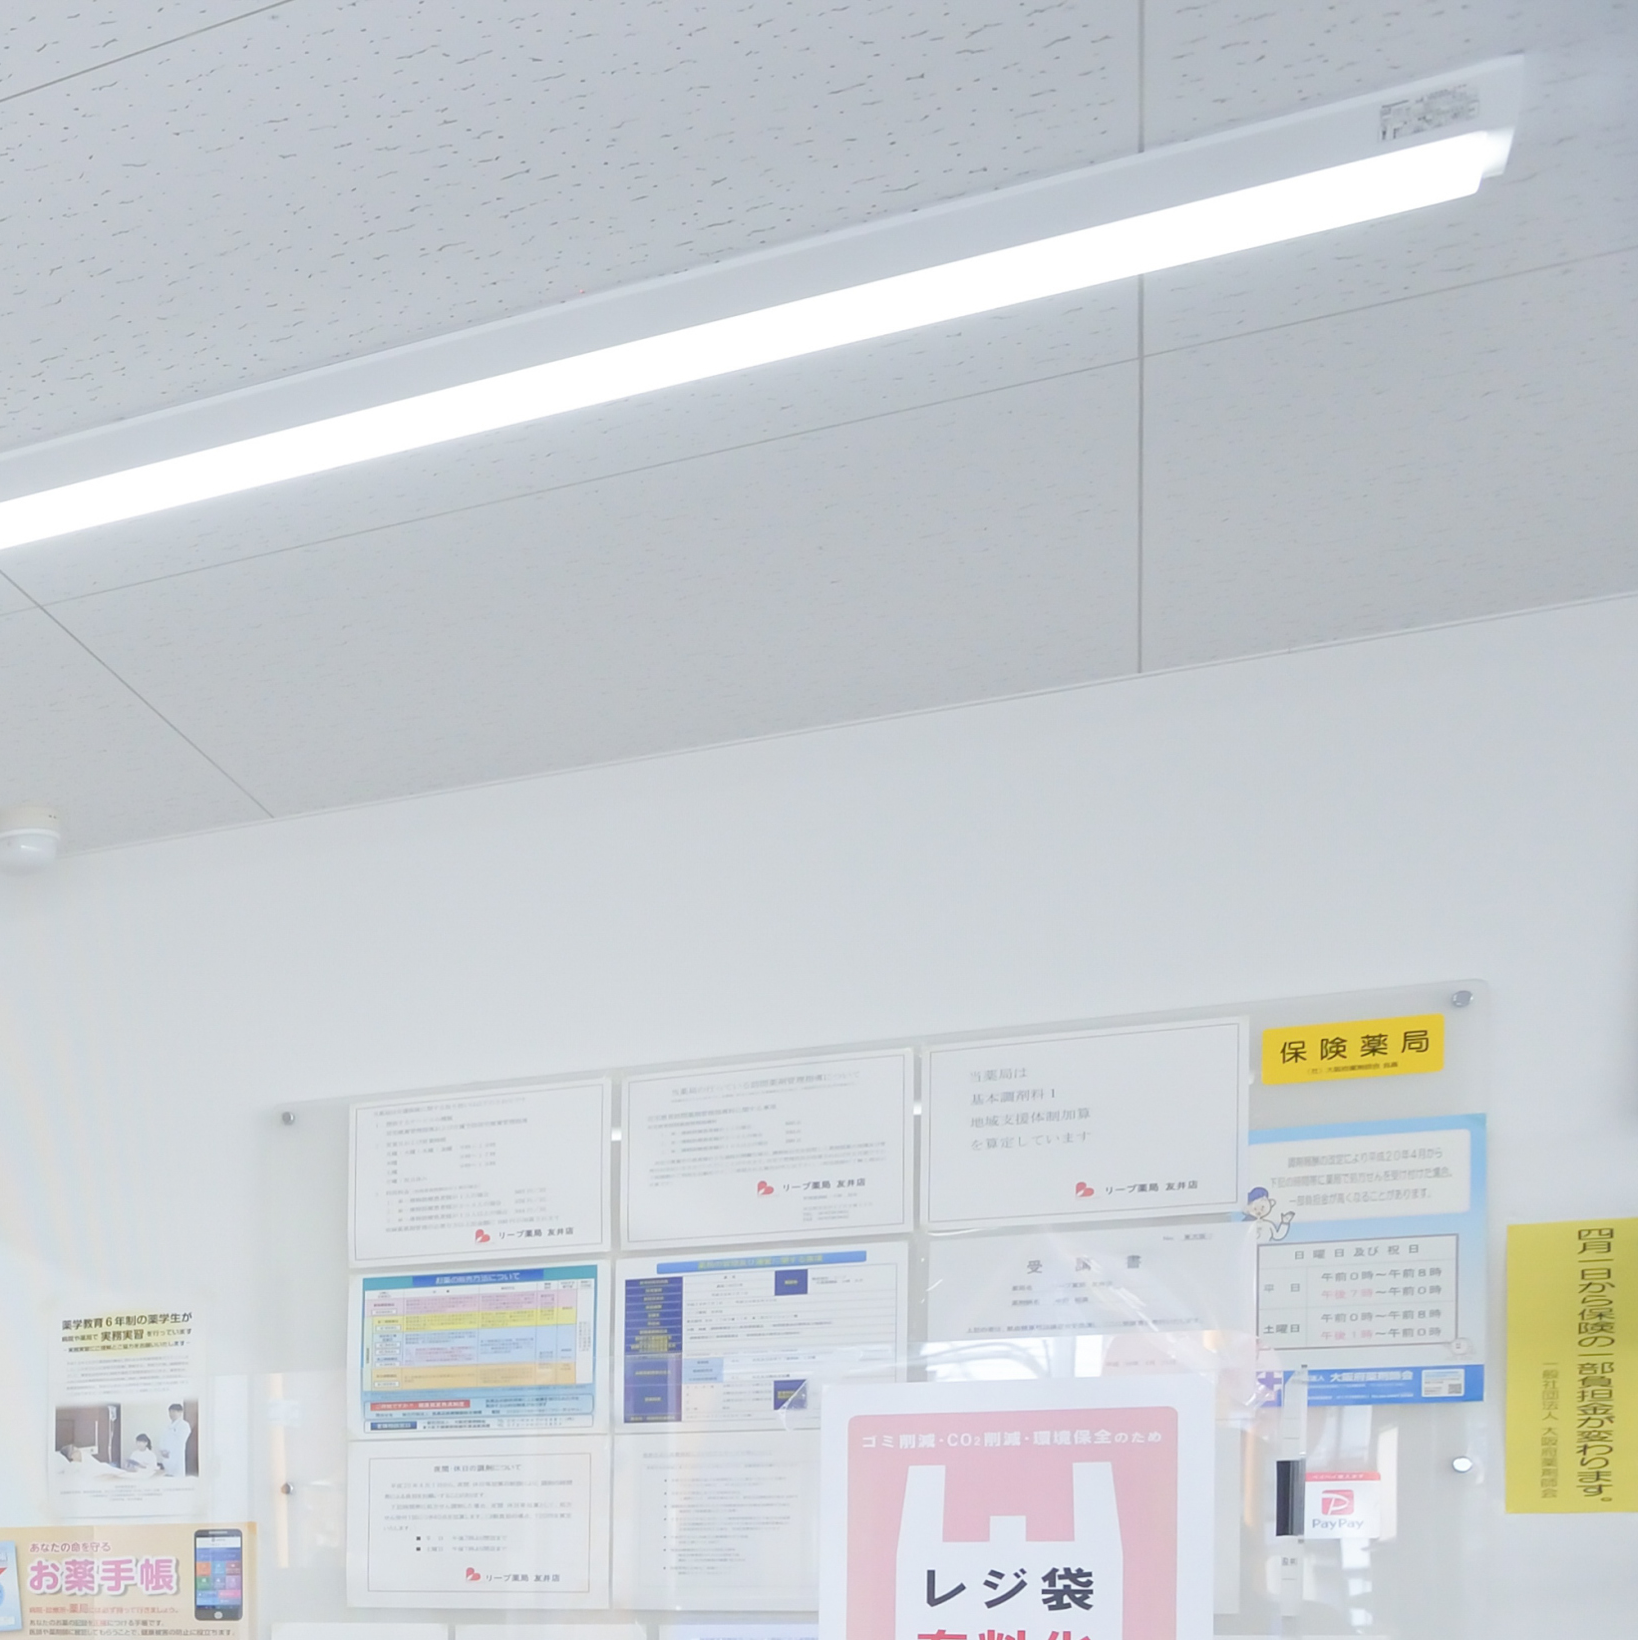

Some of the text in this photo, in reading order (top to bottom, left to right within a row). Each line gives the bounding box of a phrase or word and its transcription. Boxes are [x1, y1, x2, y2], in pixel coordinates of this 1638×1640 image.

[1280, 1030, 1430, 1064] 保険薬局
[970, 1067, 1027, 1082] 当薬局は
[970, 1108, 1091, 1128] 地域支援体制加算
[970, 1132, 1092, 1150] を算定しています
[1263, 1324, 1300, 1334] 土曜日
[1577, 1227, 1615, 1502] 四月一日から保険の一部負担金が変わります。
[1312, 1519, 1363, 1530] PayPay
[29, 1542, 111, 1552] あなたの命を守る
[29, 1558, 177, 1594] お薬手帳
[925, 1567, 1094, 1611] レジ袋
